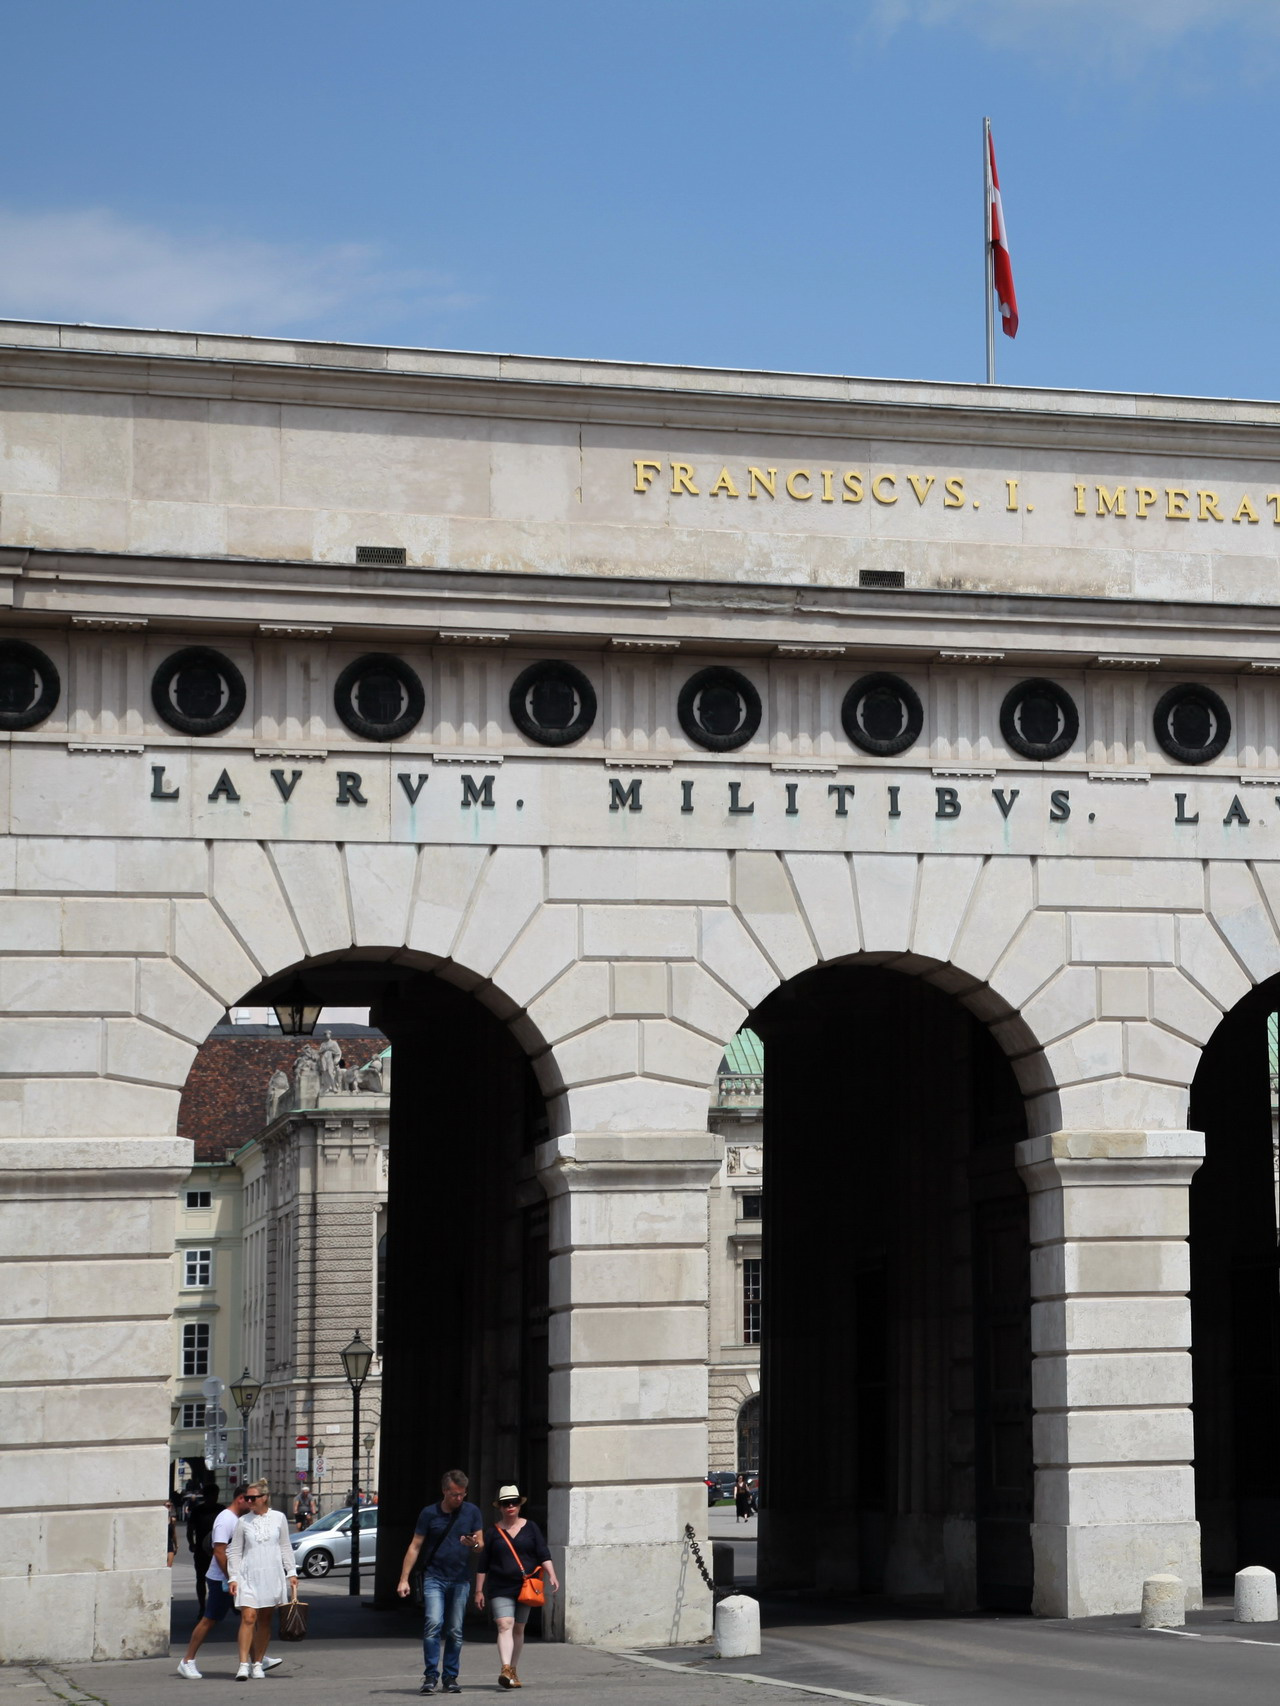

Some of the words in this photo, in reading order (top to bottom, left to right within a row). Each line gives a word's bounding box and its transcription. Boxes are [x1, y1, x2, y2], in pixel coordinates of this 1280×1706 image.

[633, 460, 980, 508] FRANCISCVS.
[1006, 479, 1034, 511] I.
[150, 766, 524, 808] LAVRVM.
[608, 778, 1096, 821] MILITIBVS.
